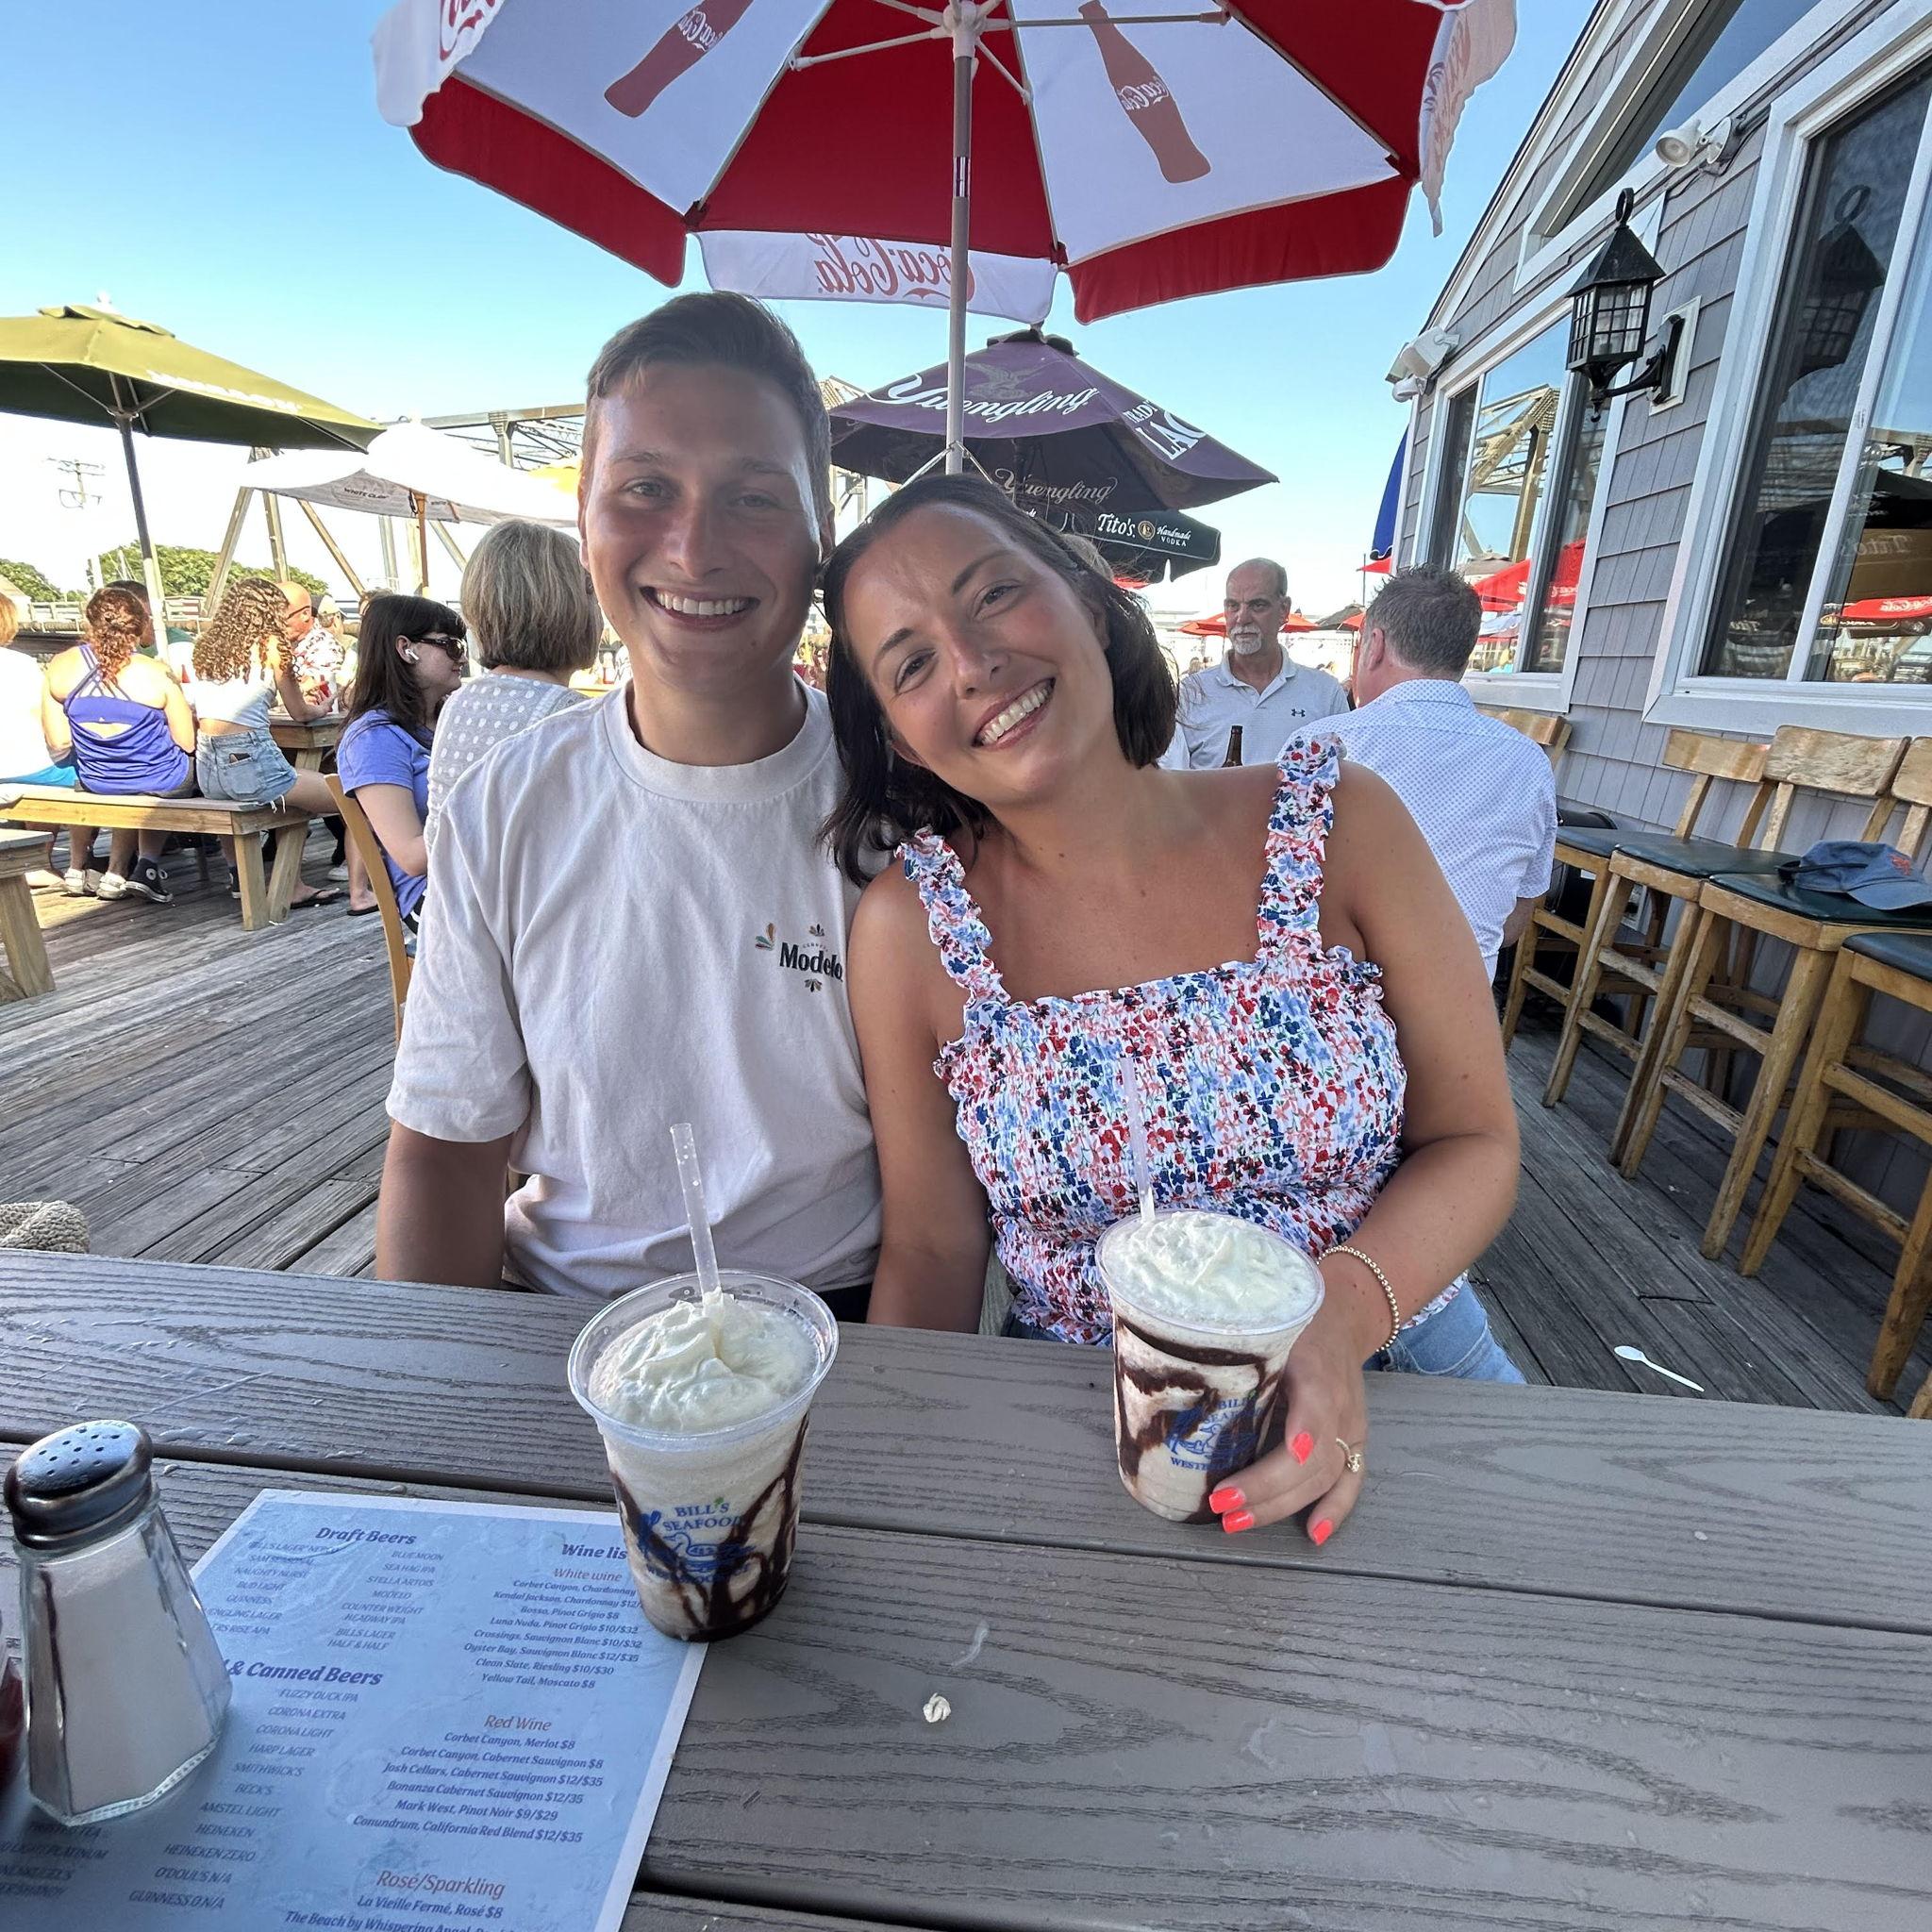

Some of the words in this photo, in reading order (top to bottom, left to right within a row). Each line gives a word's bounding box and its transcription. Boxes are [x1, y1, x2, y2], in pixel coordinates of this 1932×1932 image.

[343, 487, 367, 497] WHITE
[995, 468, 1119, 505] Yuengling
[1157, 525, 1191, 541] Handmade
[1160, 536, 1187, 547] VODKA
[779, 941, 843, 981] Modelo
[315, 1527, 366, 1541] Draft
[365, 1530, 417, 1544] Beers
[562, 1544, 605, 1557] Wine
[606, 1546, 628, 1560] lis
[554, 1568, 591, 1580] White
[591, 1571, 623, 1583] wine
[513, 1579, 546, 1590] Corbet
[582, 1584, 637, 1597] Chardonnay
[565, 1595, 620, 1608] Chardonnay
[620, 1599, 641, 1609] $12/
[550, 1607, 576, 1617] Pinot
[576, 1609, 606, 1621] Grigio
[490, 1616, 514, 1626] Luna
[542, 1620, 568, 1630] Pinot
[568, 1622, 598, 1634] Grigio
[597, 1624, 640, 1636] $10/$32
[523, 1632, 574, 1645] Sauvignon
[573, 1636, 601, 1646] Blanc
[600, 1637, 643, 1650] $10/$32
[463, 1641, 497, 1654] Oyster
[519, 1646, 571, 1660] Sauvignon
[570, 1650, 598, 1660] Blanc
[597, 1651, 640, 1663] $12/$35
[228, 1660, 244, 1675] &
[246, 1661, 327, 1681] Canned
[324, 1667, 384, 1686] Beers
[475, 1657, 504, 1669] Clean
[531, 1661, 572, 1674] Riesling
[571, 1663, 615, 1676] $10/$30
[481, 1673, 514, 1684] Yellow
[514, 1674, 537, 1686] Tail,
[537, 1677, 581, 1689] Moscato
[580, 1679, 596, 1690] $8
[268, 1707, 312, 1718] CORONA
[310, 1708, 346, 1721] EXTRA
[483, 1714, 513, 1728] Red
[516, 1716, 553, 1732] Wine
[256, 1724, 303, 1737] CORONA
[300, 1727, 335, 1738] LIGHT
[248, 1743, 280, 1754] HARP
[278, 1746, 316, 1757] LAGER
[443, 1731, 481, 1744] Corbet
[523, 1737, 561, 1750] Merlot
[558, 1739, 577, 1751] $8
[400, 1745, 438, 1758] Corbet
[482, 1750, 532, 1765] Cabernet
[530, 1754, 587, 1770] Sauvignon
[587, 1757, 605, 1770] $8
[382, 1761, 409, 1775] Josh
[408, 1763, 451, 1778] Cellars,
[450, 1766, 500, 1781] Cabernet
[500, 1770, 558, 1786] Sauvignon
[557, 1774, 604, 1788] $12/$35
[387, 1779, 437, 1794] Bonanza
[435, 1782, 486, 1798] Cabernet
[486, 1787, 544, 1803] Sauvignon
[543, 1791, 585, 1805] $12/35
[200, 1802, 244, 1814] AMSTEL
[243, 1806, 283, 1818] LIGHT
[394, 1799, 427, 1812] Mark
[426, 1801, 458, 1816] West,
[458, 1804, 489, 1817] Pinot
[489, 1806, 515, 1819] Noir
[514, 1807, 559, 1822] $9/$29
[194, 1824, 256, 1838] HEINEKEN
[352, 1814, 422, 1831] Conundrum,
[422, 1819, 480, 1836] California
[477, 1824, 503, 1837] Red
[501, 1825, 536, 1840] Blend
[534, 1828, 585, 1844] $12/$35
[163, 1843, 224, 1859] HEINEKEN
[221, 1848, 257, 1862] ZERO
[208, 1871, 234, 1885] N/A
[376, 1869, 508, 1901] Rosé/Sparkling
[128, 1890, 191, 1906] GUINNESS
[200, 1895, 226, 1909] N/A
[356, 1894, 374, 1908] La
[375, 1895, 413, 1911] Vieille
[450, 1903, 487, 1919] Rosé
[284, 1910, 308, 1924] The
[307, 1911, 346, 1928] Beach
[344, 1913, 365, 1932] by
[364, 1917, 436, 1932] Whispering
